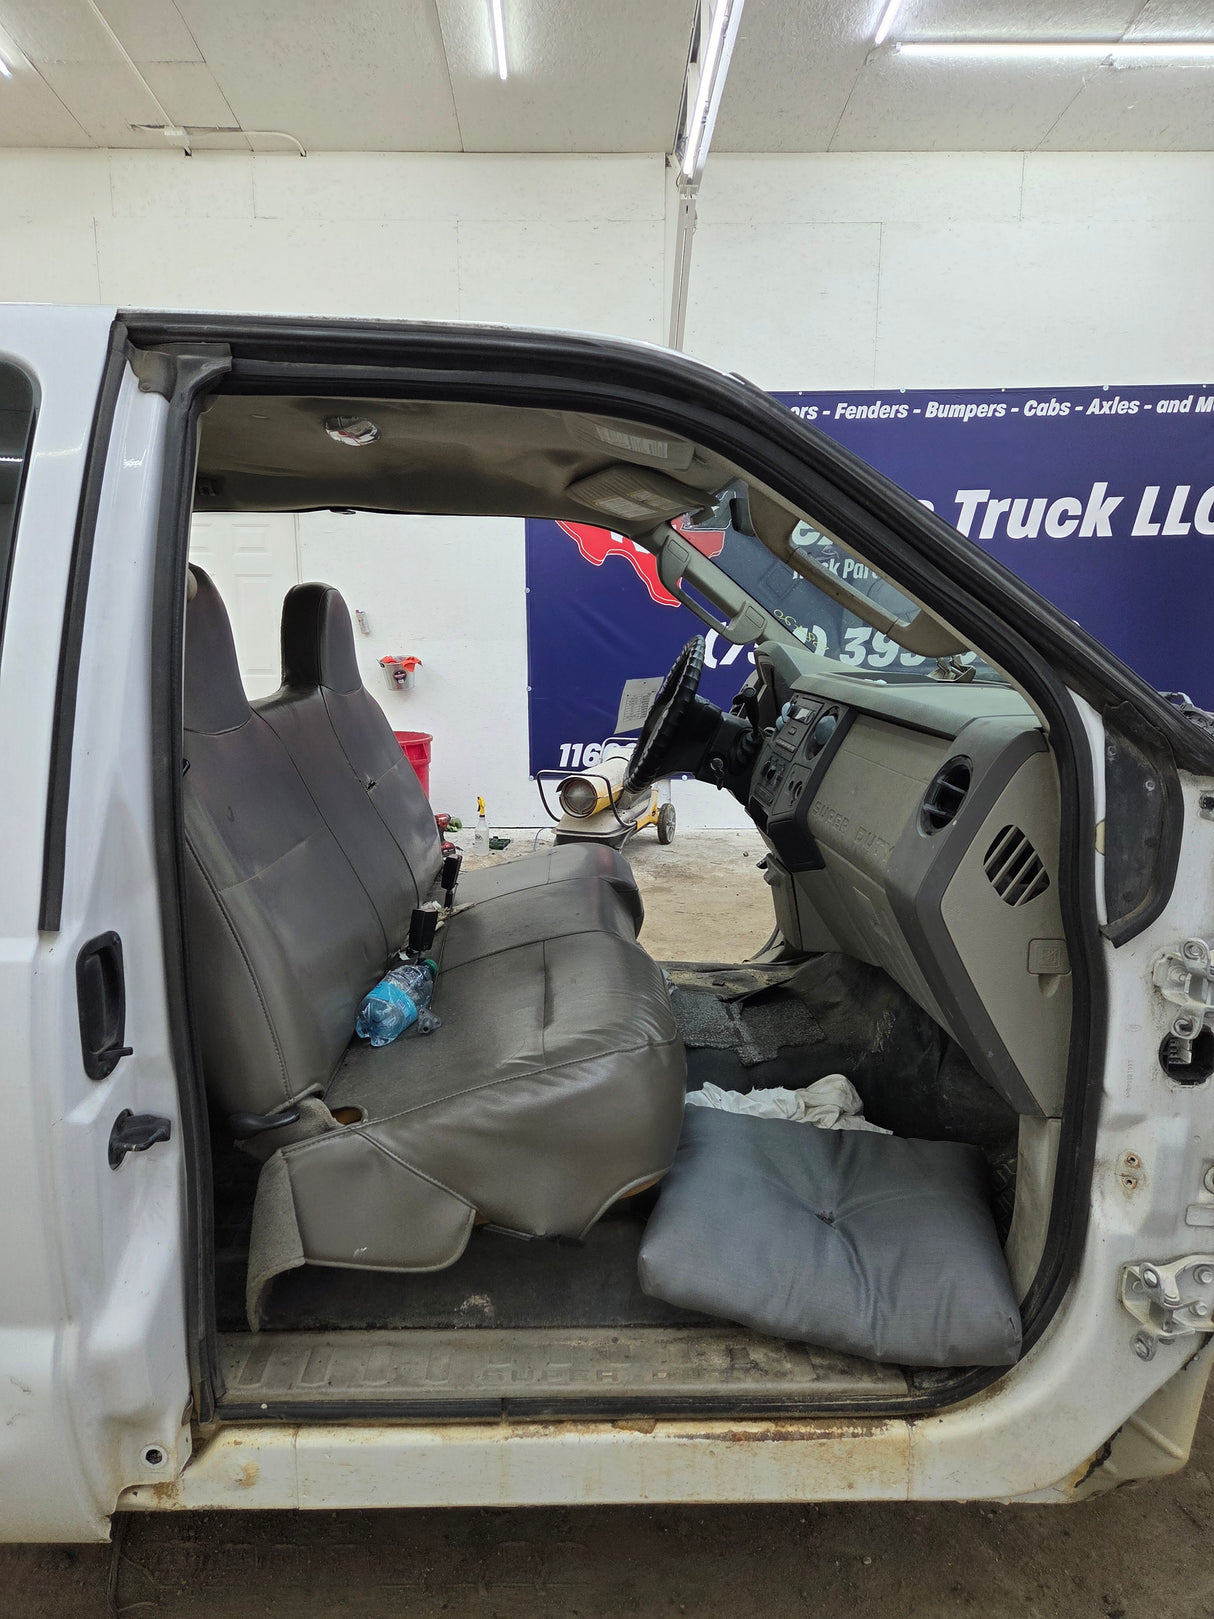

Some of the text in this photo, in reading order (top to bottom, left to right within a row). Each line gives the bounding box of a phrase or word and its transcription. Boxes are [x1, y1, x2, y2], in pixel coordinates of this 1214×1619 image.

[834, 400, 909, 420] Fenders
[924, 401, 1007, 422] Bumpers
[1023, 398, 1071, 417] Cabs
[1085, 396, 1140, 415] Axles
[1156, 395, 1194, 413] and
[954, 481, 1214, 540] Truck LLC
